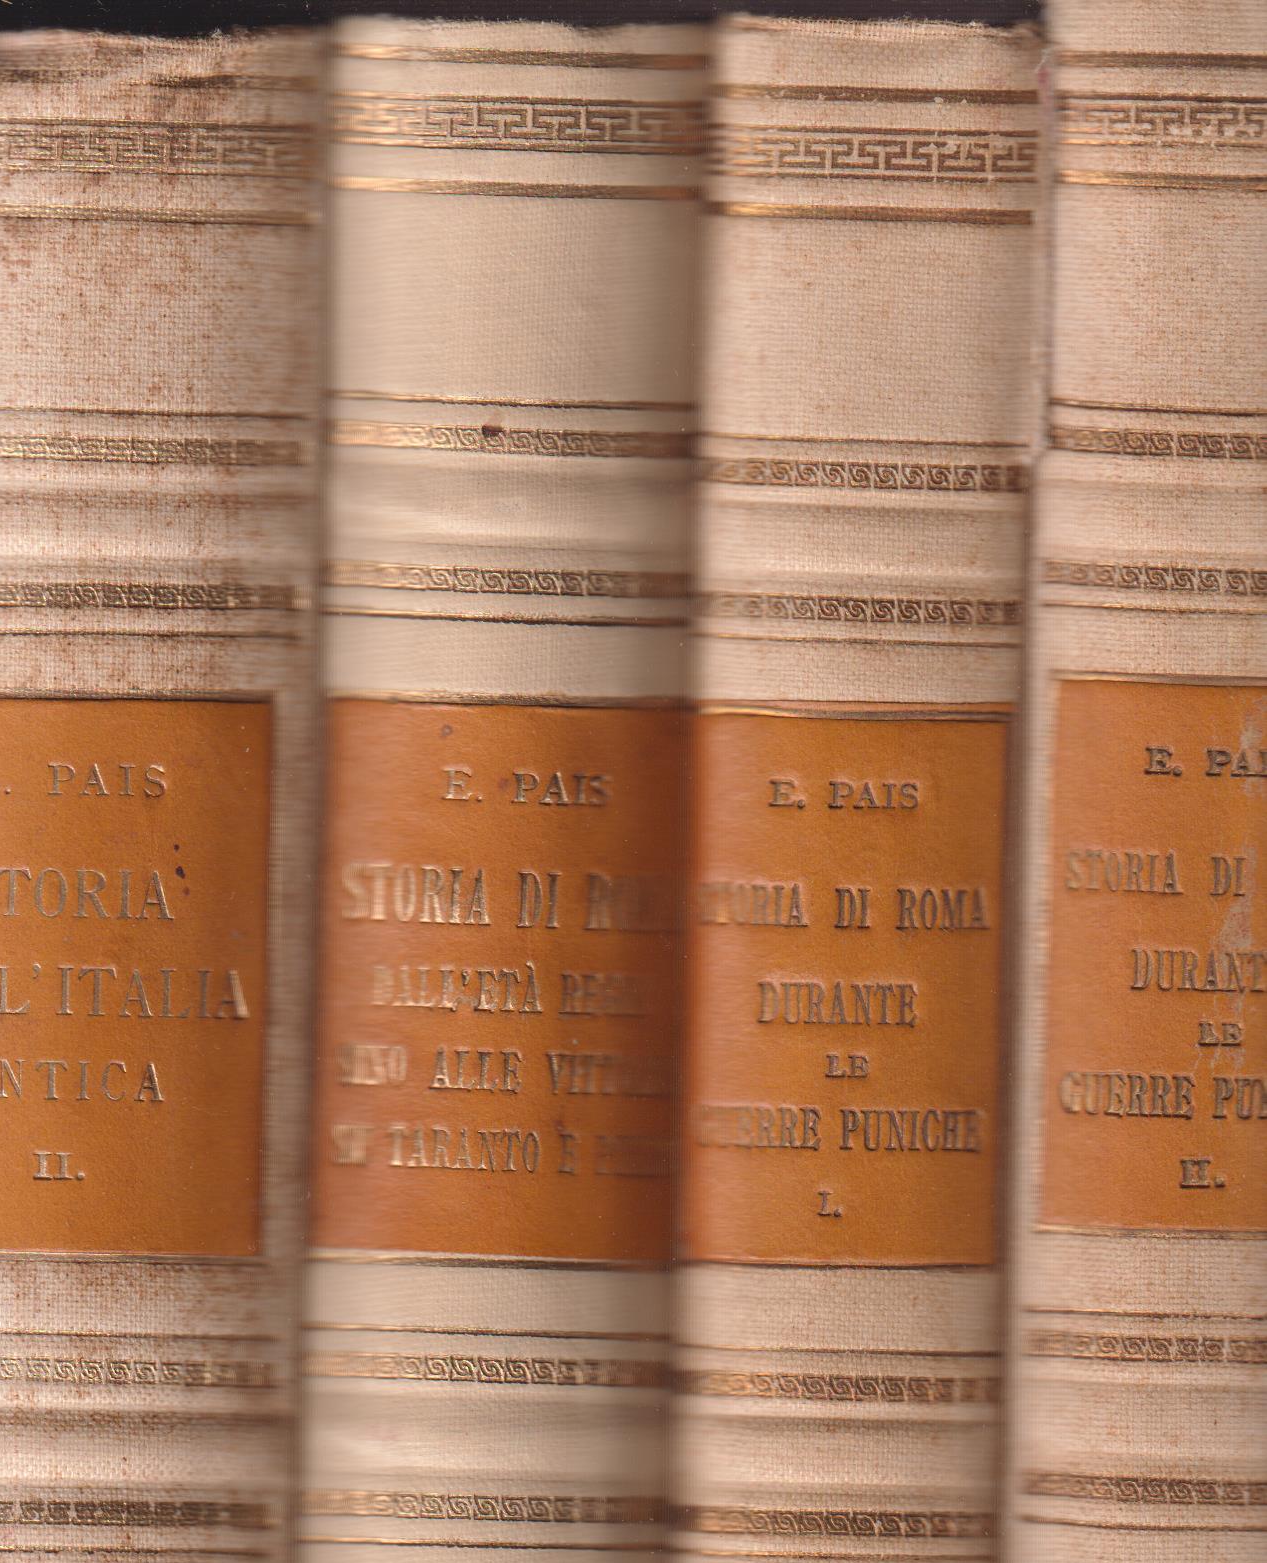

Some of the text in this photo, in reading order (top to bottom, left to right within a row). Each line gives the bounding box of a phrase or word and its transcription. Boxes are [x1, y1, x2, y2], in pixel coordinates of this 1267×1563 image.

[47, 762, 168, 799] PAIS
[1144, 747, 1182, 777] E.
[441, 766, 612, 806] E. PAIS
[769, 779, 918, 809] E. PAIS
[1065, 849, 1245, 897] STORIA DI
[341, 864, 492, 926] STORIA
[517, 870, 563, 929] DI
[835, 887, 871, 928] DI
[895, 887, 991, 930] ROMA
[758, 981, 918, 1028] DURANTE
[1198, 1021, 1242, 1047] LE
[430, 1047, 523, 1094] ALLE
[826, 1054, 870, 1078] LE
[1061, 1071, 1194, 1120] GUERRE
[387, 1128, 540, 1173] TARANTO
[839, 1108, 982, 1154] PUNICHE
[33, 1151, 85, 1181] II.
